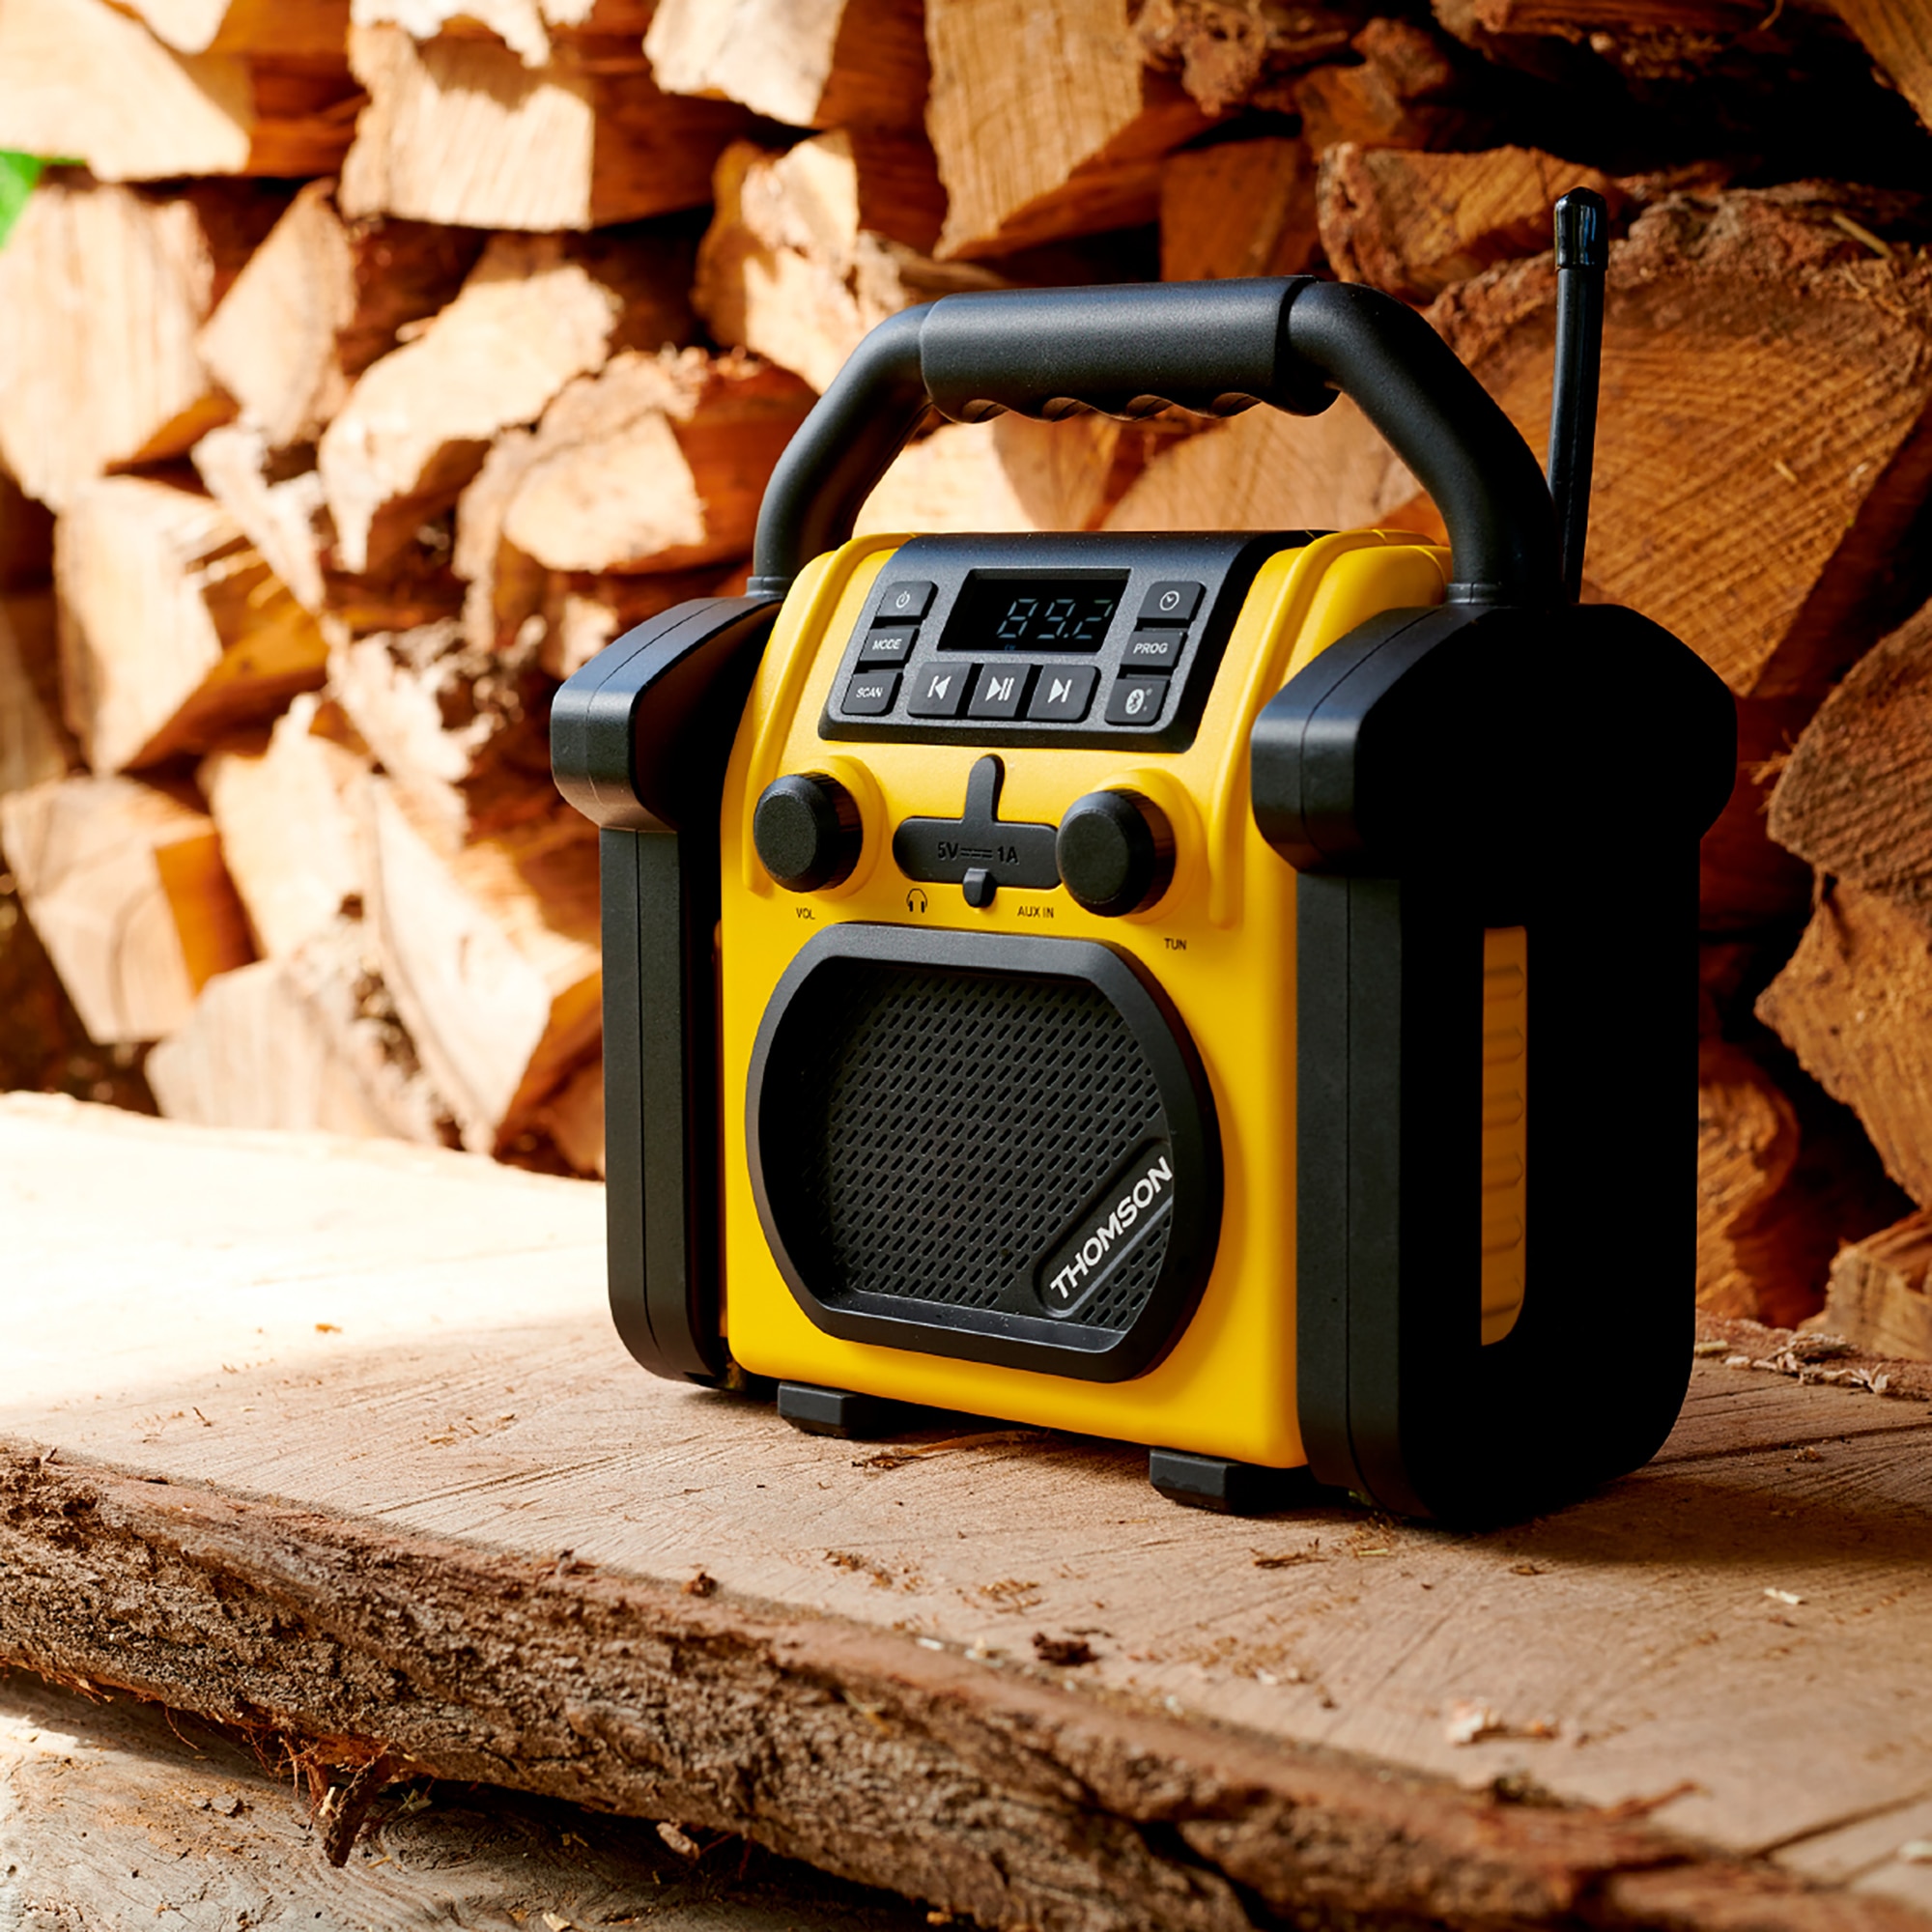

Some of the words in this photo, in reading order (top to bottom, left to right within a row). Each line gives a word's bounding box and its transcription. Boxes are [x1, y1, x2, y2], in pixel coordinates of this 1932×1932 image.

[996, 598, 1114, 639] 89.2
[871, 639, 902, 650] MODE
[1133, 642, 1169, 654] PROG
[856, 687, 884, 697] SCAN
[796, 907, 815, 920] VOL
[1017, 906, 1040, 918] AUX
[1042, 907, 1055, 918] IN
[1164, 937, 1187, 950] TUN
[1049, 1155, 1174, 1299] THOMSON
